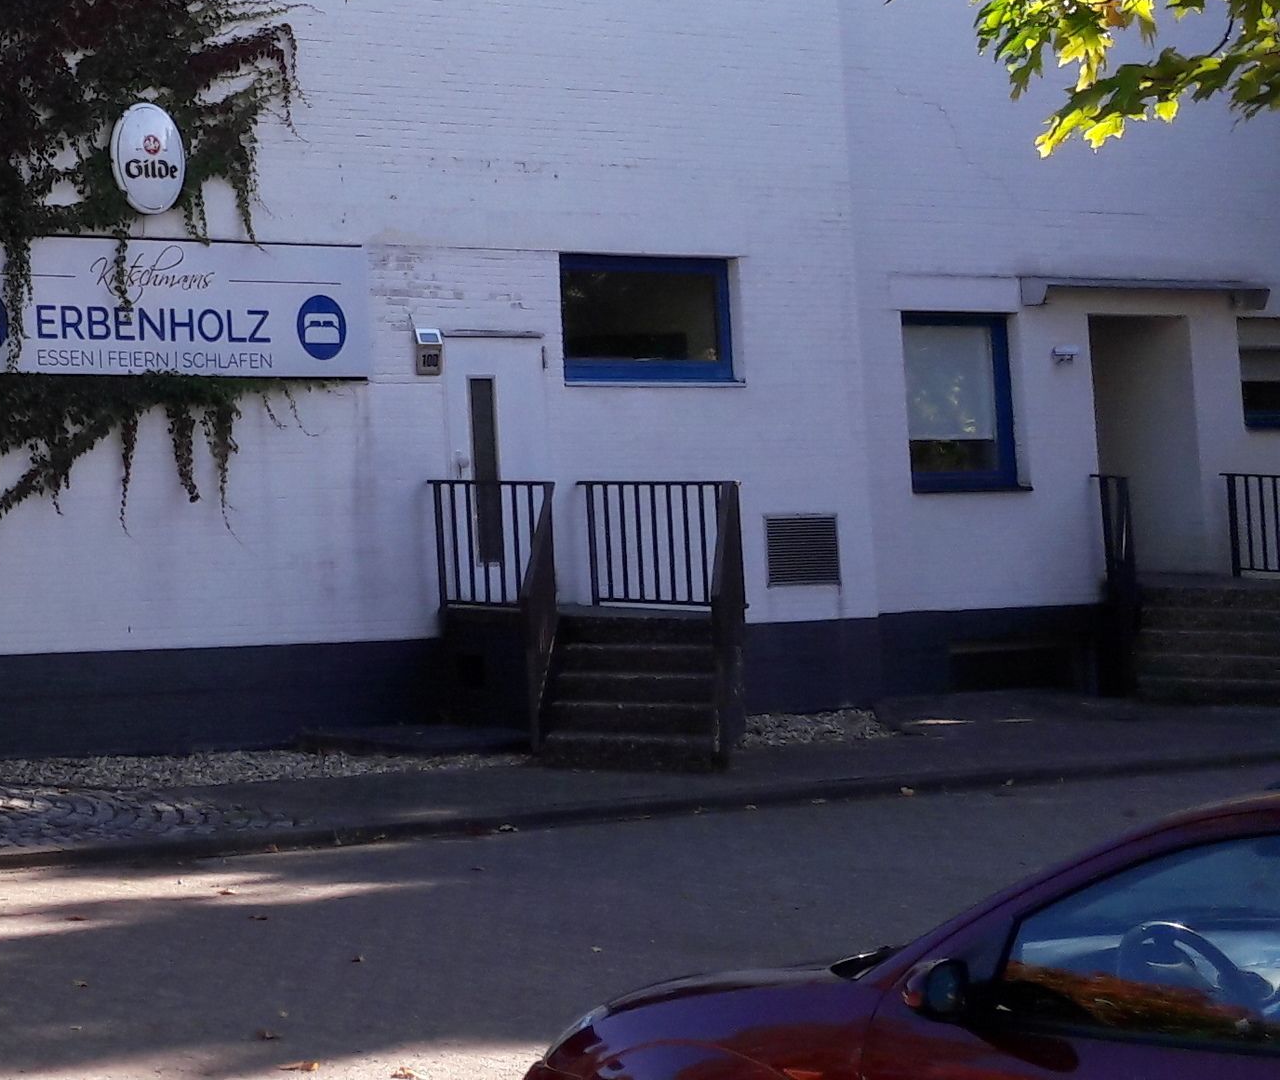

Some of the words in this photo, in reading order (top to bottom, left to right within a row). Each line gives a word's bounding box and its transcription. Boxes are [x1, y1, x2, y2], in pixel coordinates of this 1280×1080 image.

[125, 159, 178, 179] Gilde
[36, 305, 271, 343] ERBENHOLZ
[37, 349, 94, 367] ESSEN
[108, 351, 169, 368] FEIERN
[182, 352, 273, 369] SCHLAFEN
